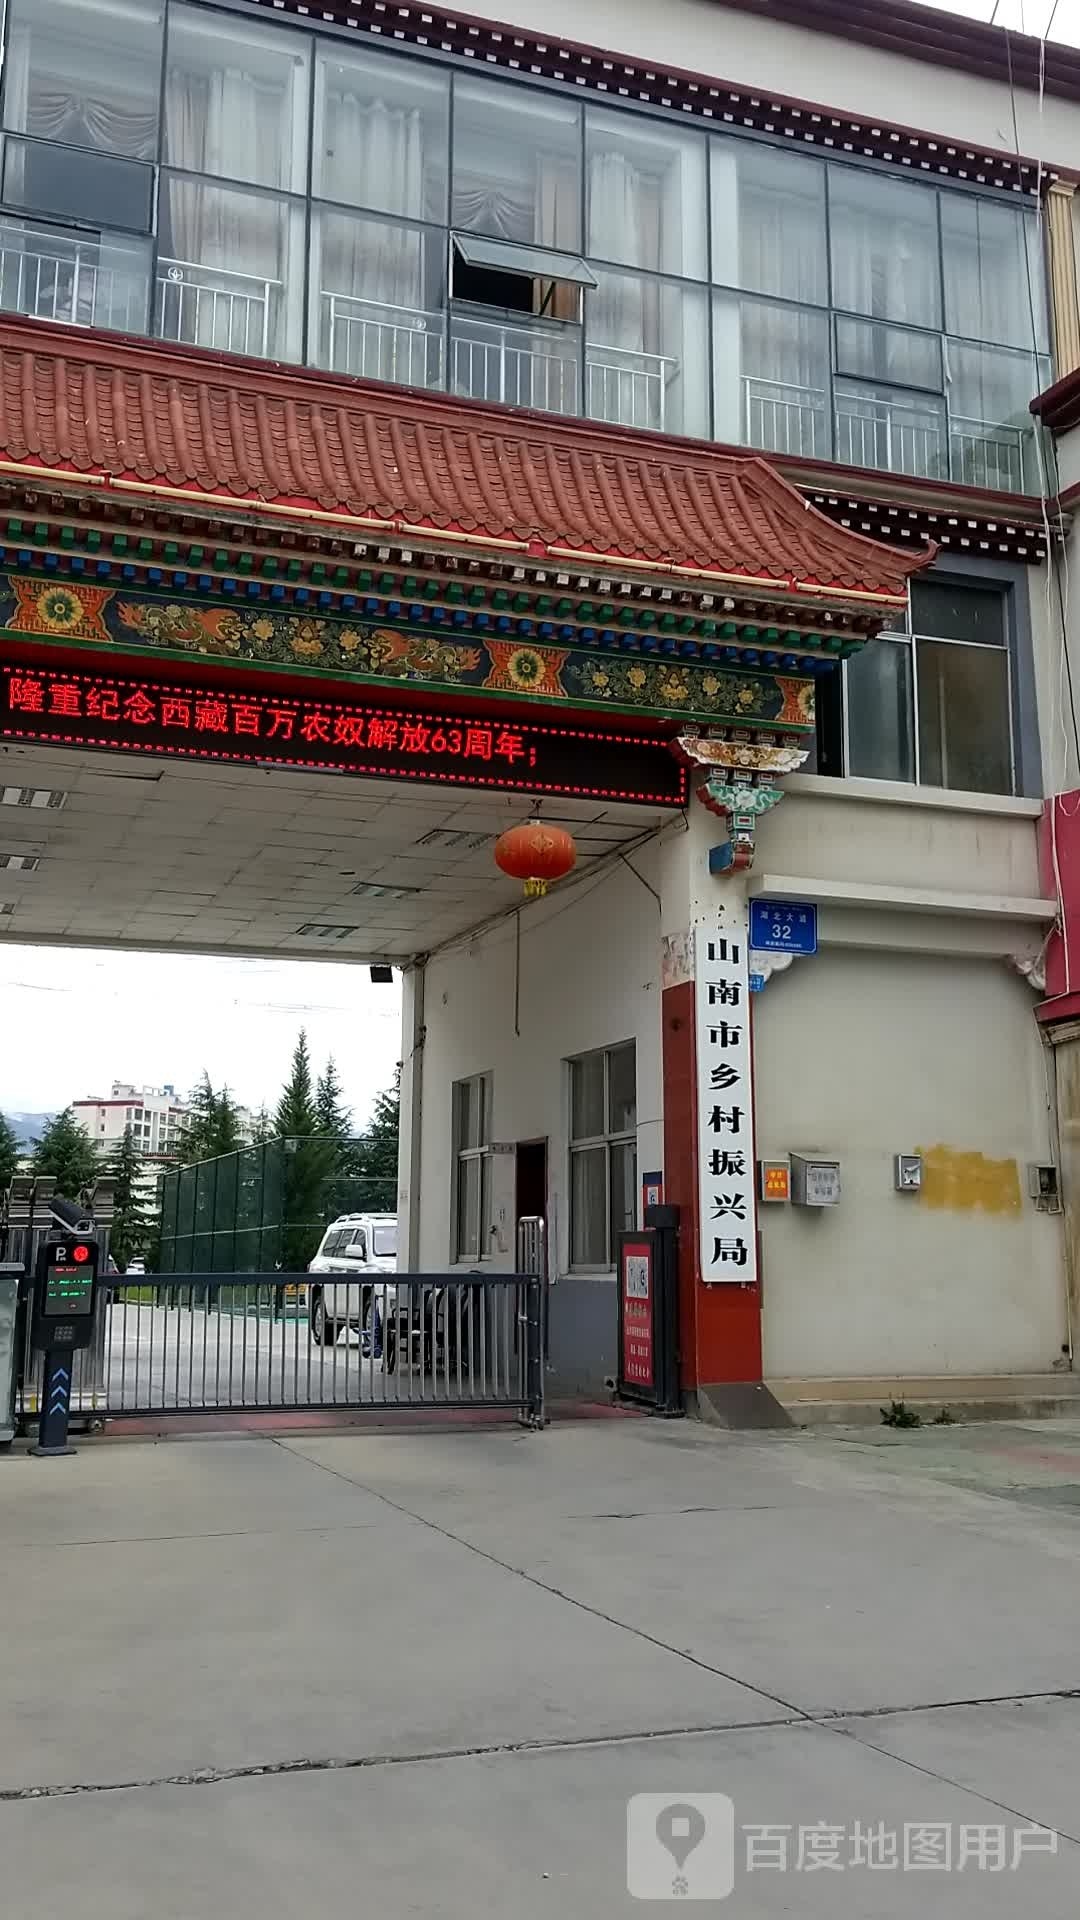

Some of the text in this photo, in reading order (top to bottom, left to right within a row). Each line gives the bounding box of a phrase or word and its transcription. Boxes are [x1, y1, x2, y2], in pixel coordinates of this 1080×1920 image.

[772, 924, 792, 939] 32
[705, 937, 749, 1267] 山南市乡村振兴局
